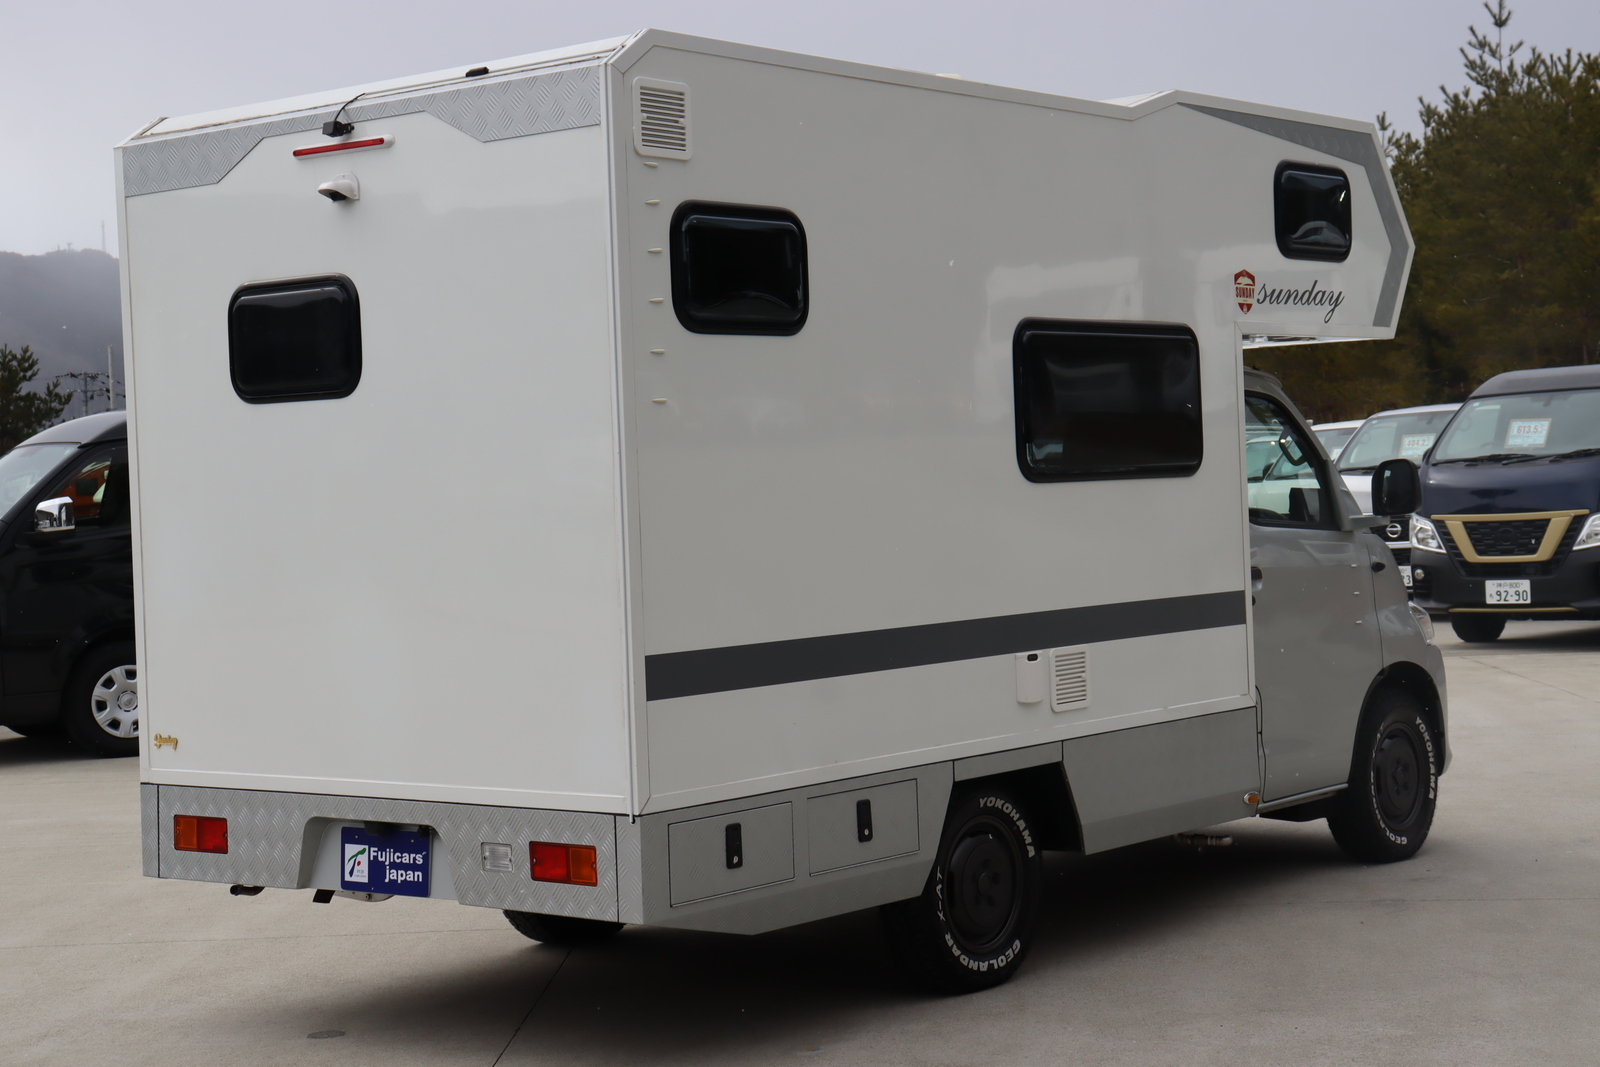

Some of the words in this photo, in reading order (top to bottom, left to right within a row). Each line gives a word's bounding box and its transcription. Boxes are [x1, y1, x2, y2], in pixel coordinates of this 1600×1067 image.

[1235, 286, 1255, 299] SUNDAY
[1257, 279, 1345, 324] sunday
[1495, 590, 1529, 602] 92-90
[1415, 716, 1437, 800] YOKOHAMA
[978, 796, 1036, 859] YOKOHAMA
[370, 847, 424, 866] Fujicars
[384, 866, 423, 884] japan
[944, 931, 1021, 972] GEOLANDAR
